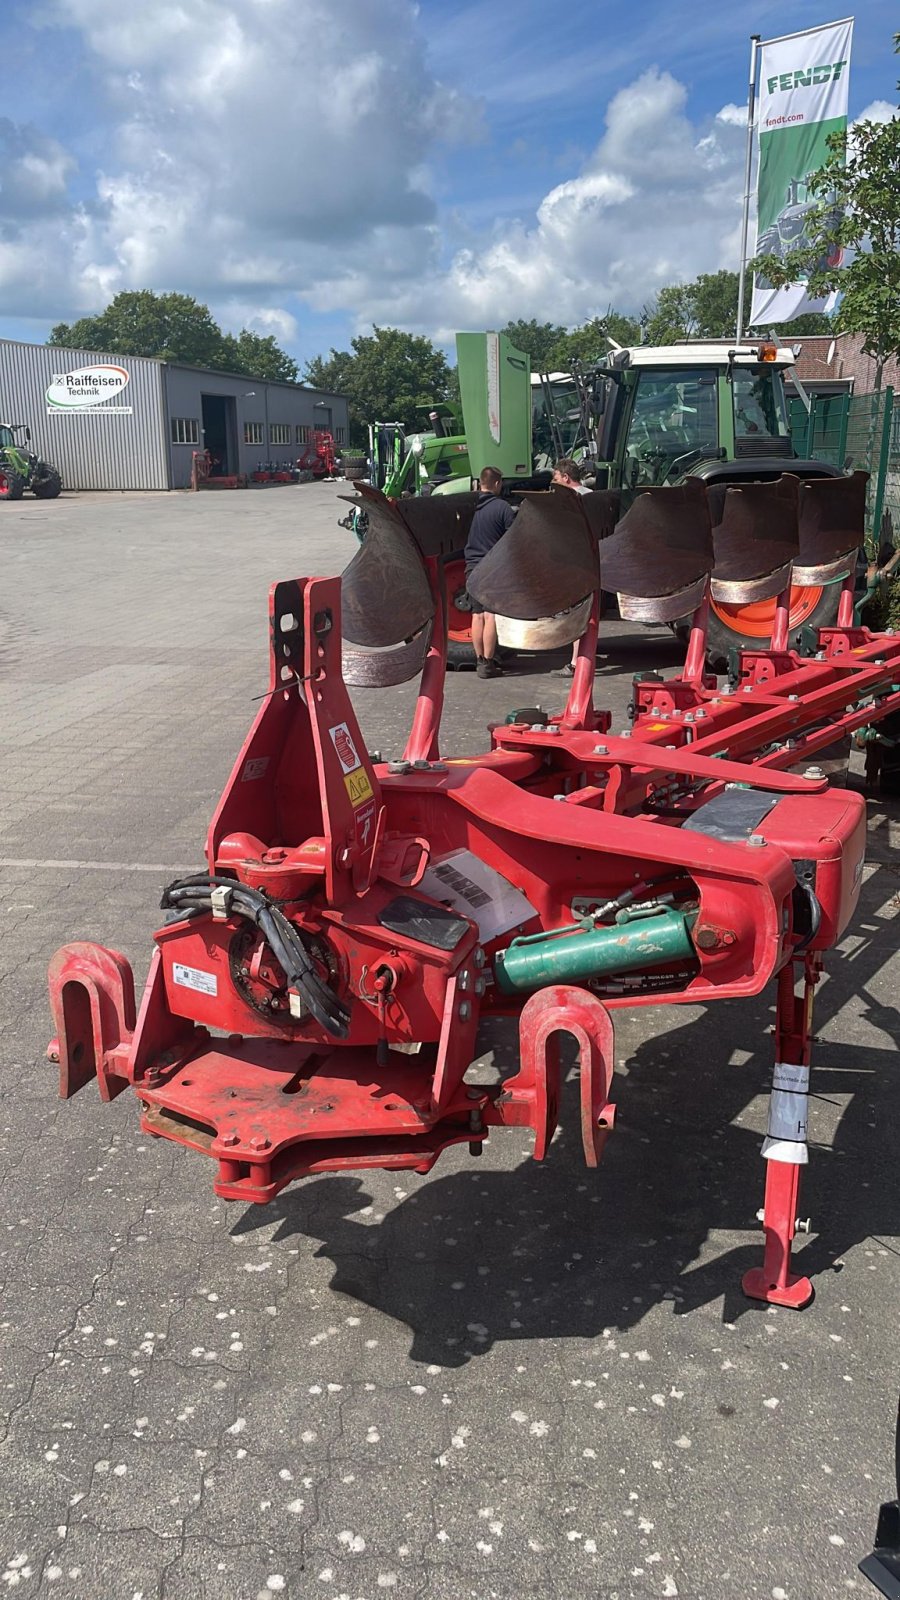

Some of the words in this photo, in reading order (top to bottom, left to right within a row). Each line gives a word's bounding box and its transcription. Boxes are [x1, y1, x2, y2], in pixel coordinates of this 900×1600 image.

[767, 60, 847, 95] FENDT
[766, 114, 804, 127] fendt.com
[66, 376, 122, 386] Raiffeisen
[67, 388, 100, 396] Technik
